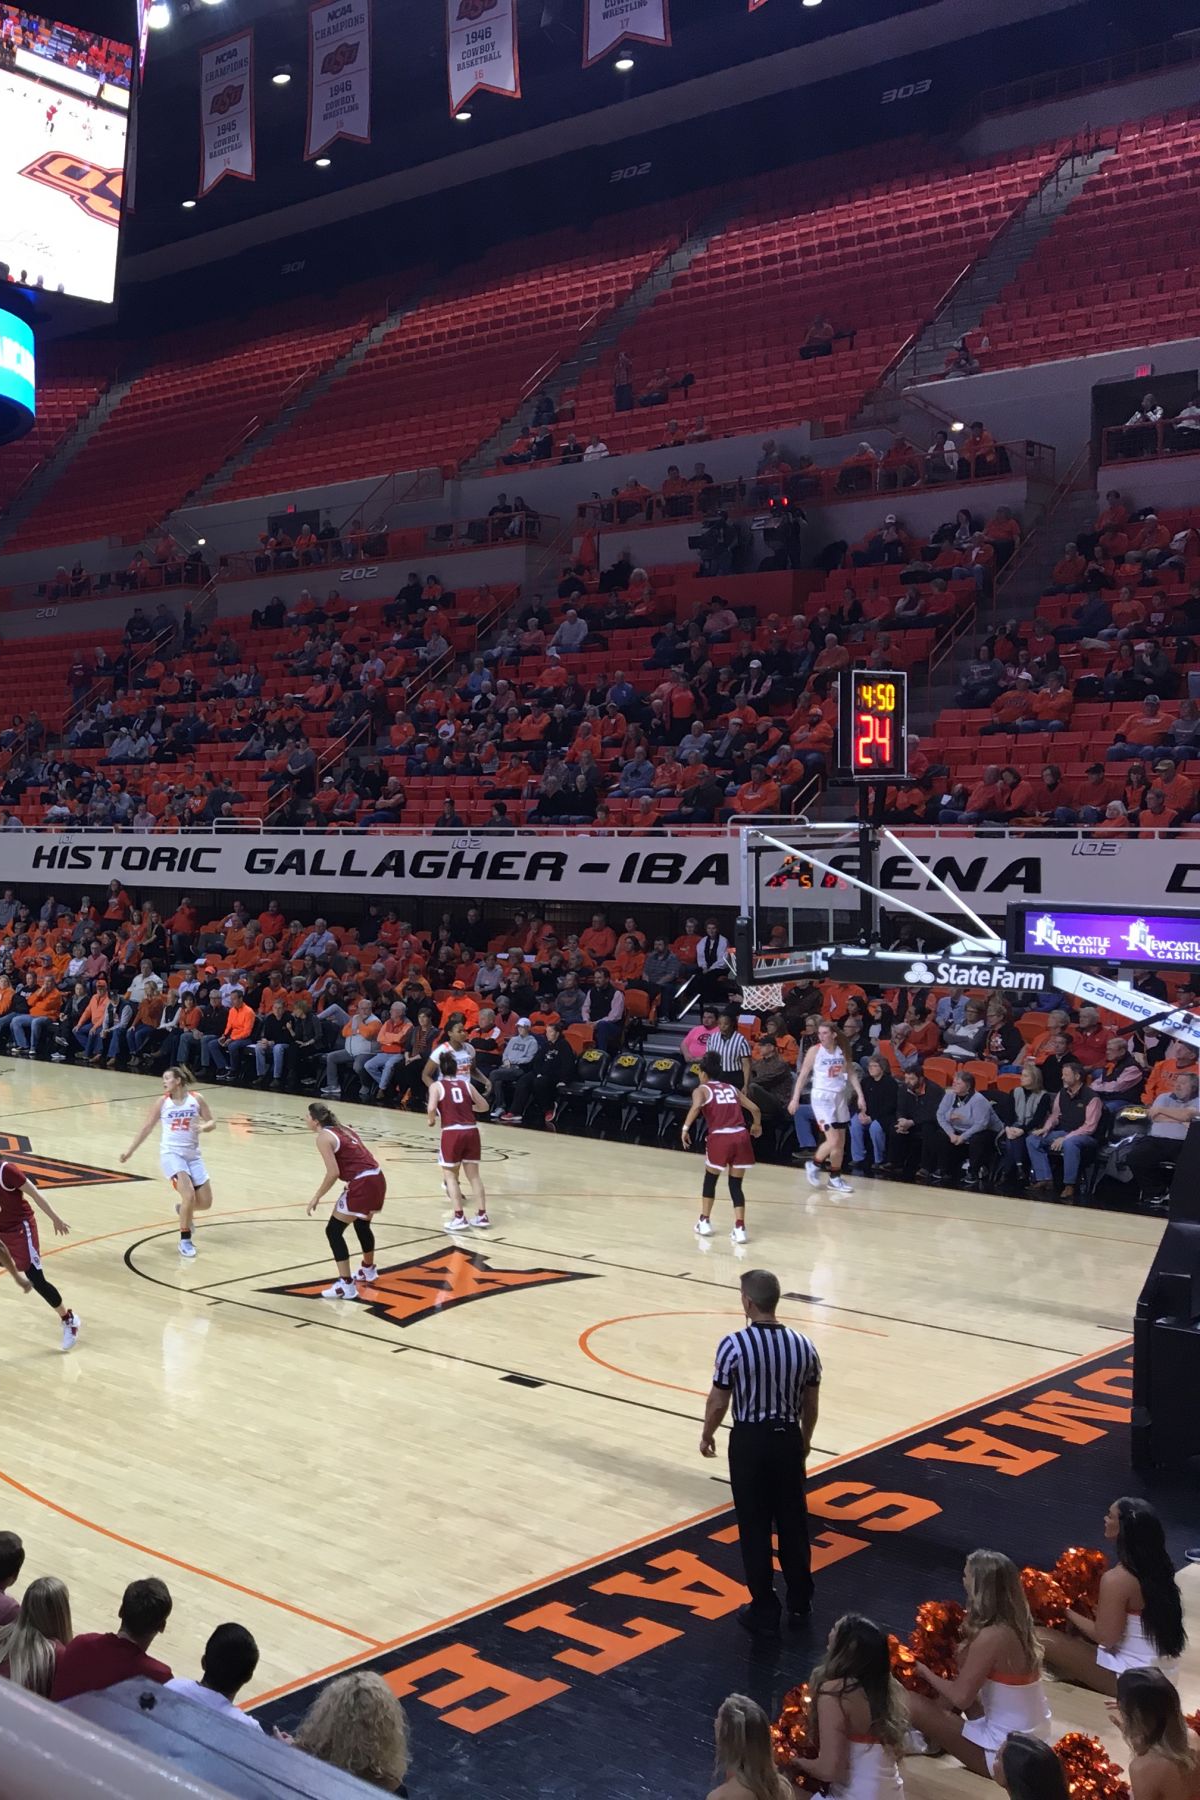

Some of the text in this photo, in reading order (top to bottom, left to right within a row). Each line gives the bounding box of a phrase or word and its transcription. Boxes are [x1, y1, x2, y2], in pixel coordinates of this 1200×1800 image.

[602, 0, 648, 20] WRESTLING
[314, 13, 365, 40] CHAMPIONS
[620, 18, 630, 30] 17
[466, 27, 492, 45] 1946
[461, 41, 496, 60] COWBOY
[456, 50, 502, 71] BASKETBALL
[205, 57, 249, 83] CHAMPIONS
[881, 79, 932, 104] 303
[322, 103, 360, 120] WRESTLING
[325, 94, 356, 112] COWBOY
[216, 120, 237, 137] 1945
[213, 133, 240, 150] COWBOY
[209, 144, 243, 160] BASKETBALL
[609, 161, 653, 184] 302
[339, 566, 379, 582] 202
[36, 606, 59, 620] 201
[861, 683, 895, 711] 4:50
[858, 714, 891, 764] 24
[451, 838, 483, 850] 102
[1071, 841, 1122, 857] 103
[32, 845, 222, 873] HISTORIC
[1028, 914, 1111, 952] NEWCASTLE
[1120, 918, 1200, 958] NEWCASTL
[1062, 945, 1107, 956] CASINO
[1095, 987, 1200, 1039] Schelde ports
[451, 1087, 464, 1104] 0
[713, 1088, 738, 1104] 22
[167, 1109, 197, 1119] STATE
[170, 1117, 192, 1132] 25
